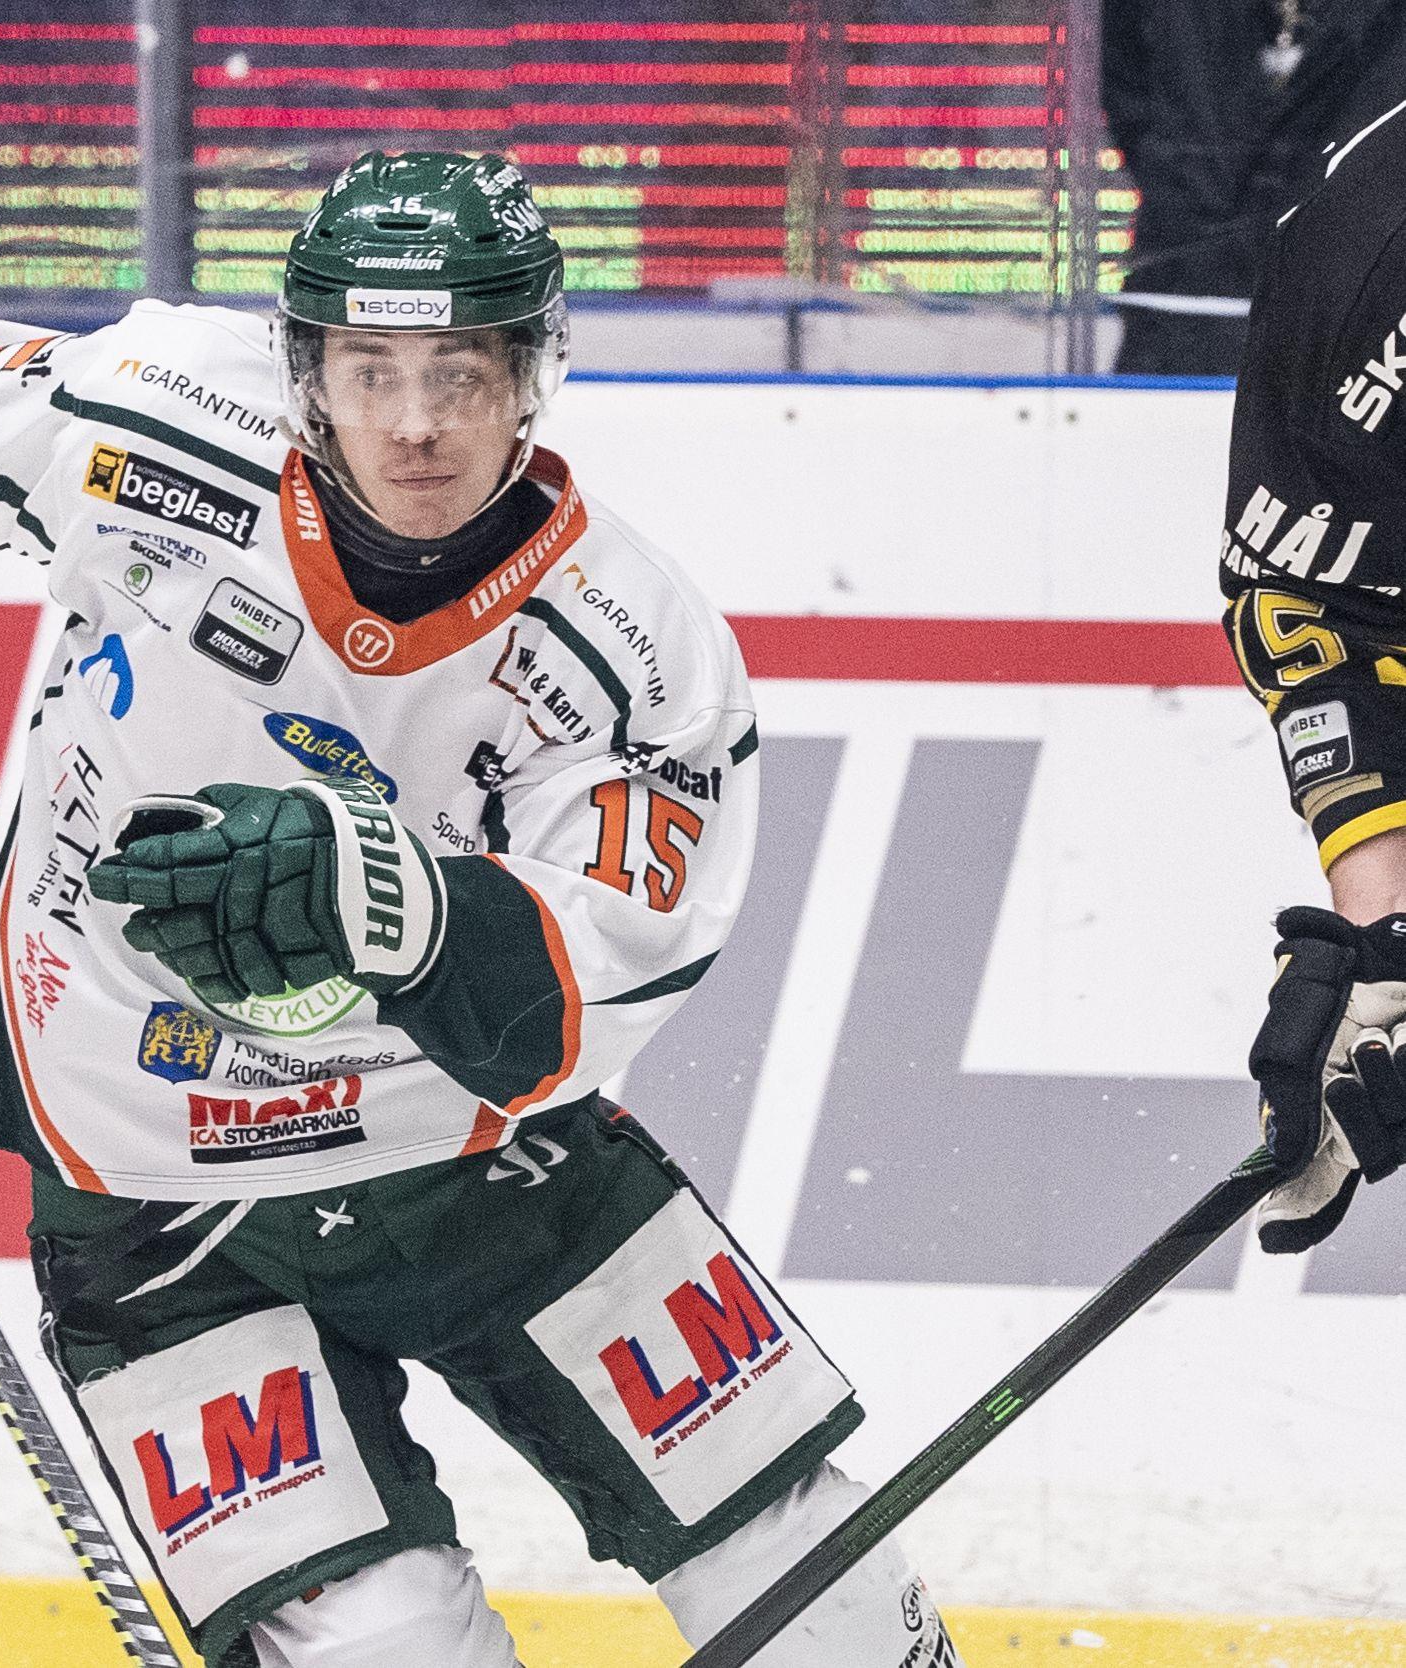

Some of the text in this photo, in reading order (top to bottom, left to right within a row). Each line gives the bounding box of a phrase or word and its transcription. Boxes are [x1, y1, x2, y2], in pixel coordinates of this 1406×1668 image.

[388, 195, 423, 214] 15
[354, 256, 444, 271] WARRIOR
[140, 364, 277, 441] GARANTUM
[119, 461, 251, 543] beglast
[230, 595, 283, 632] UNIBET
[212, 629, 270, 664] HOCKEY
[582, 777, 705, 914] 15
[189, 1108, 361, 1146] ICA STORMARKNAD
[597, 1250, 784, 1442] LM
[748, 1339, 794, 1382] Transport
[132, 1365, 321, 1538] LM
[254, 1464, 327, 1503] Transport
